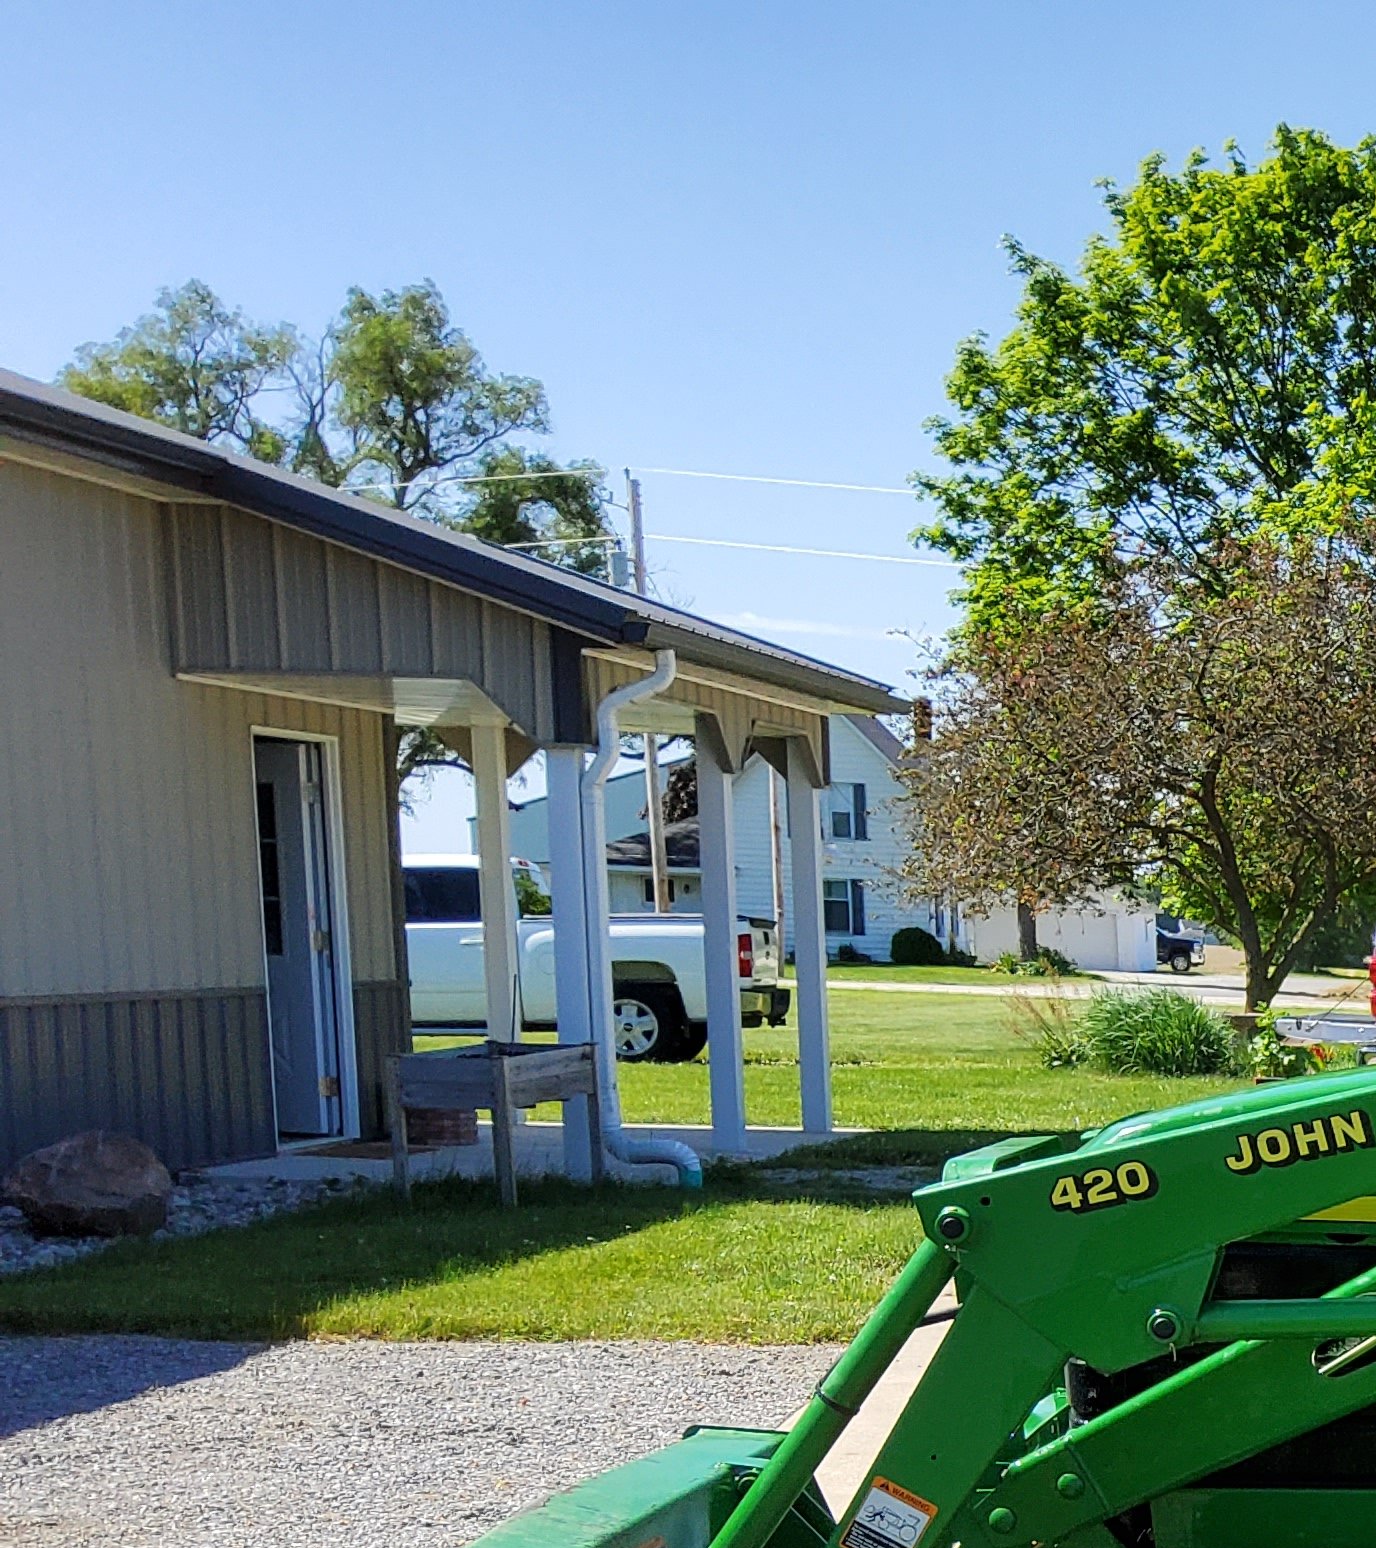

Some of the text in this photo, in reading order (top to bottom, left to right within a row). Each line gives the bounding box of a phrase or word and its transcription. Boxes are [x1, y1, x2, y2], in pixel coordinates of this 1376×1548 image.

[1225, 1109, 1372, 1173] JOHN
[1050, 1161, 1154, 1212] 420
[891, 1486, 930, 1513] WARNING
